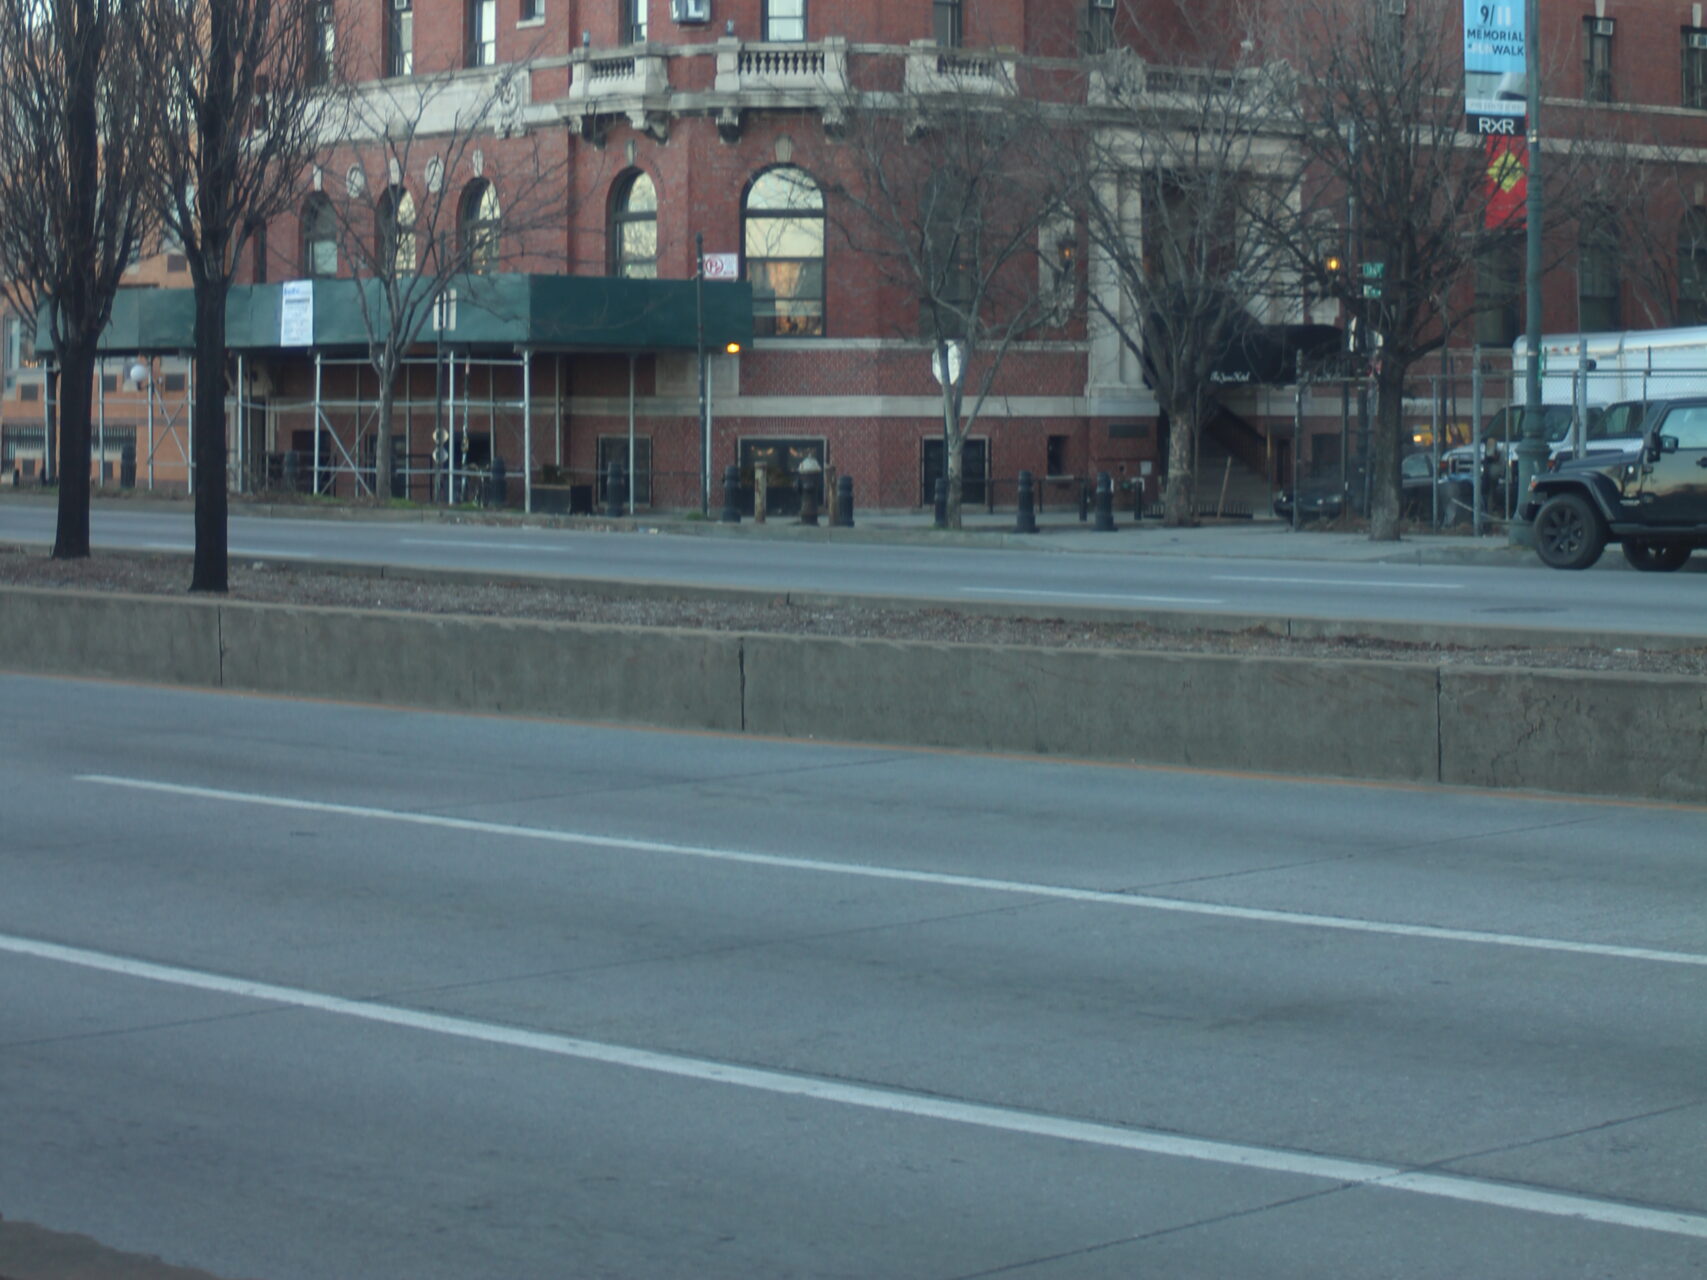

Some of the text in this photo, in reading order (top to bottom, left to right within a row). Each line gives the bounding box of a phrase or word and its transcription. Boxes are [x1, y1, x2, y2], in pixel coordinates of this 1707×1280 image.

[1480, 4, 1511, 26] 9/11
[1467, 29, 1523, 42] MEMORIAL
[1492, 45, 1524, 56] WALK
[1479, 117, 1514, 135] RXR
